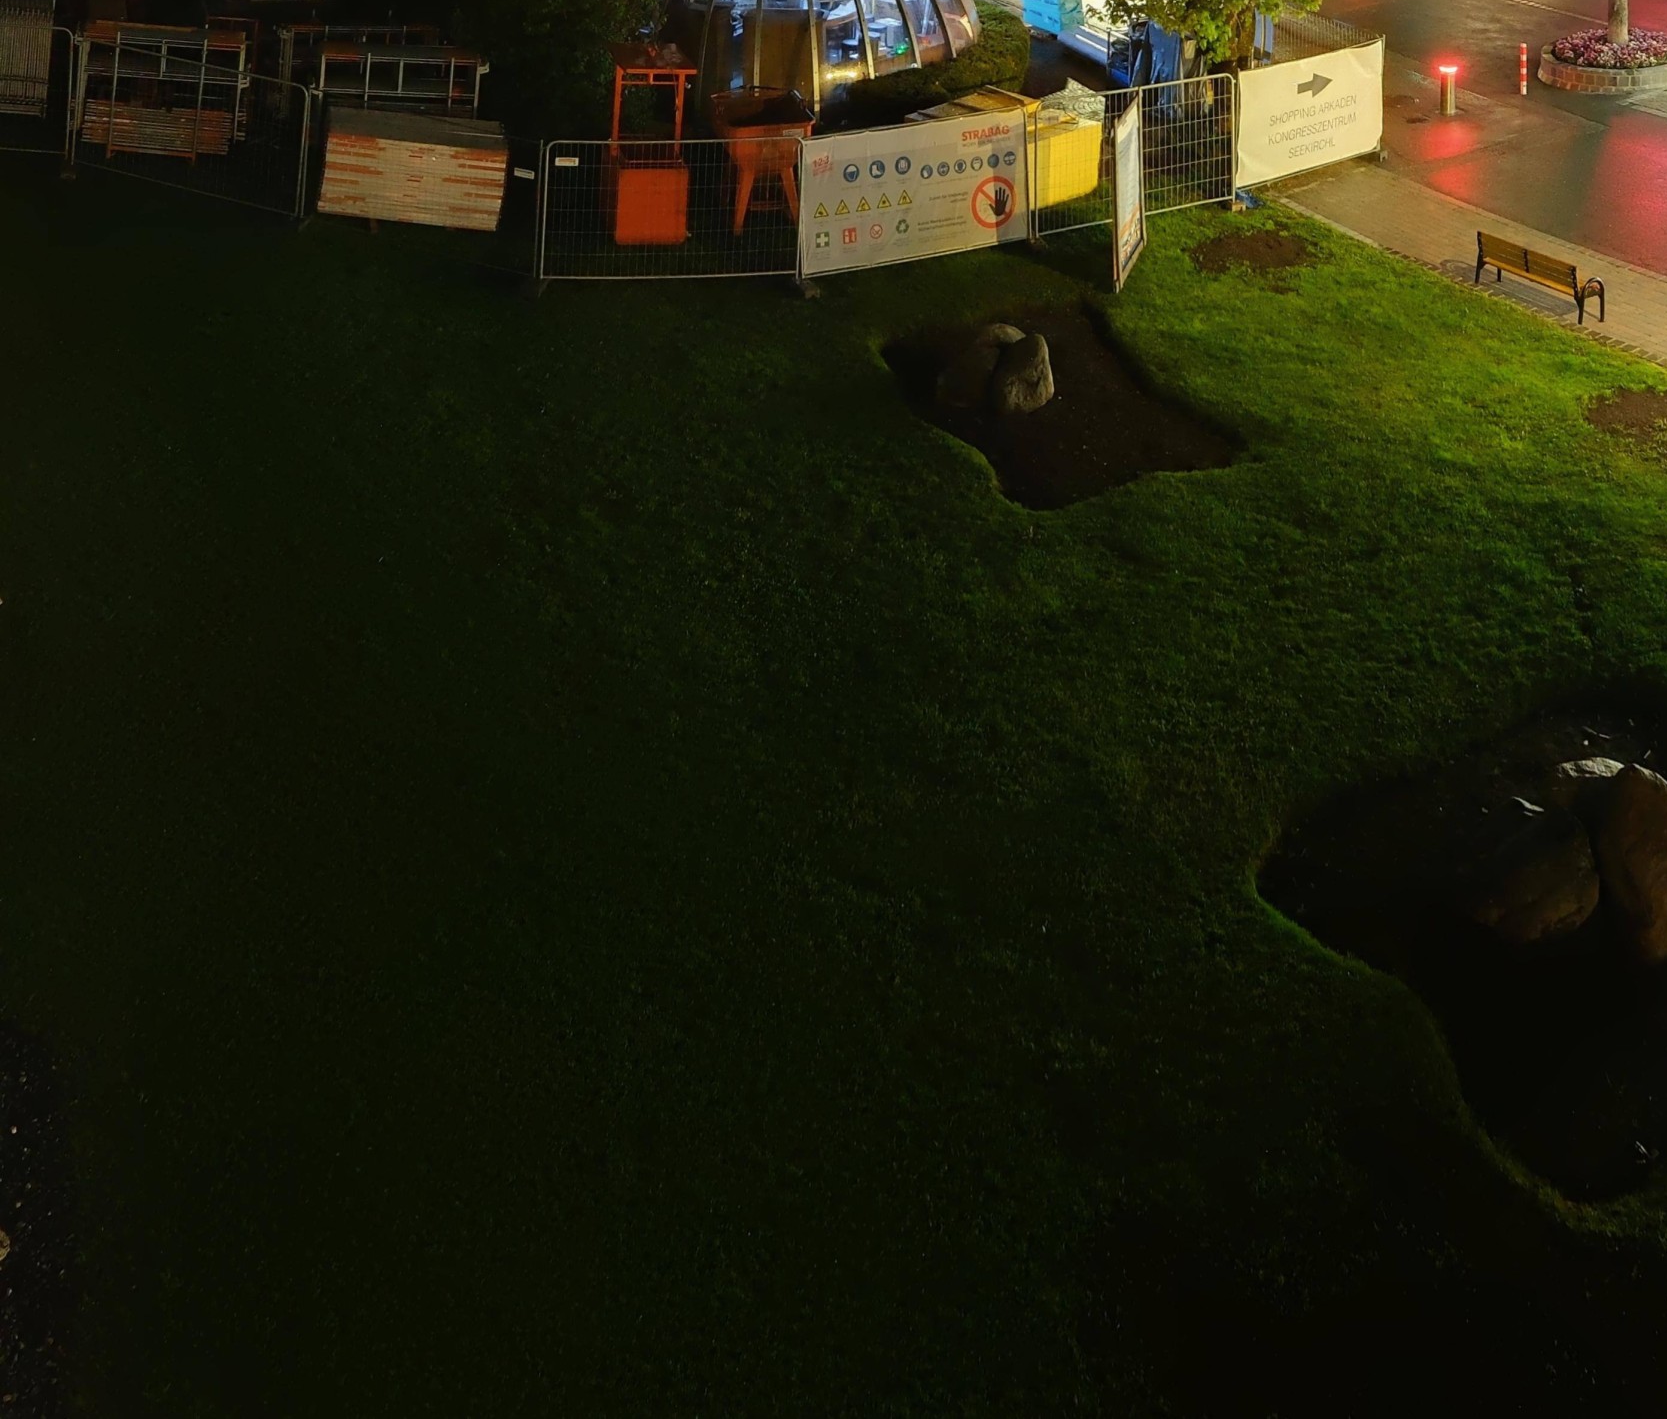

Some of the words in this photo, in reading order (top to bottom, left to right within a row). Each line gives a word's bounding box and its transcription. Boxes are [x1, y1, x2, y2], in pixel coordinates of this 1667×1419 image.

[1269, 105, 1316, 127] SHOPPING
[1317, 94, 1357, 116] ARKADEN
[961, 124, 1010, 142] STRABAG
[1267, 112, 1357, 146] KONGRESSZENTRUM
[1288, 137, 1336, 160] SEEKIRCHL
